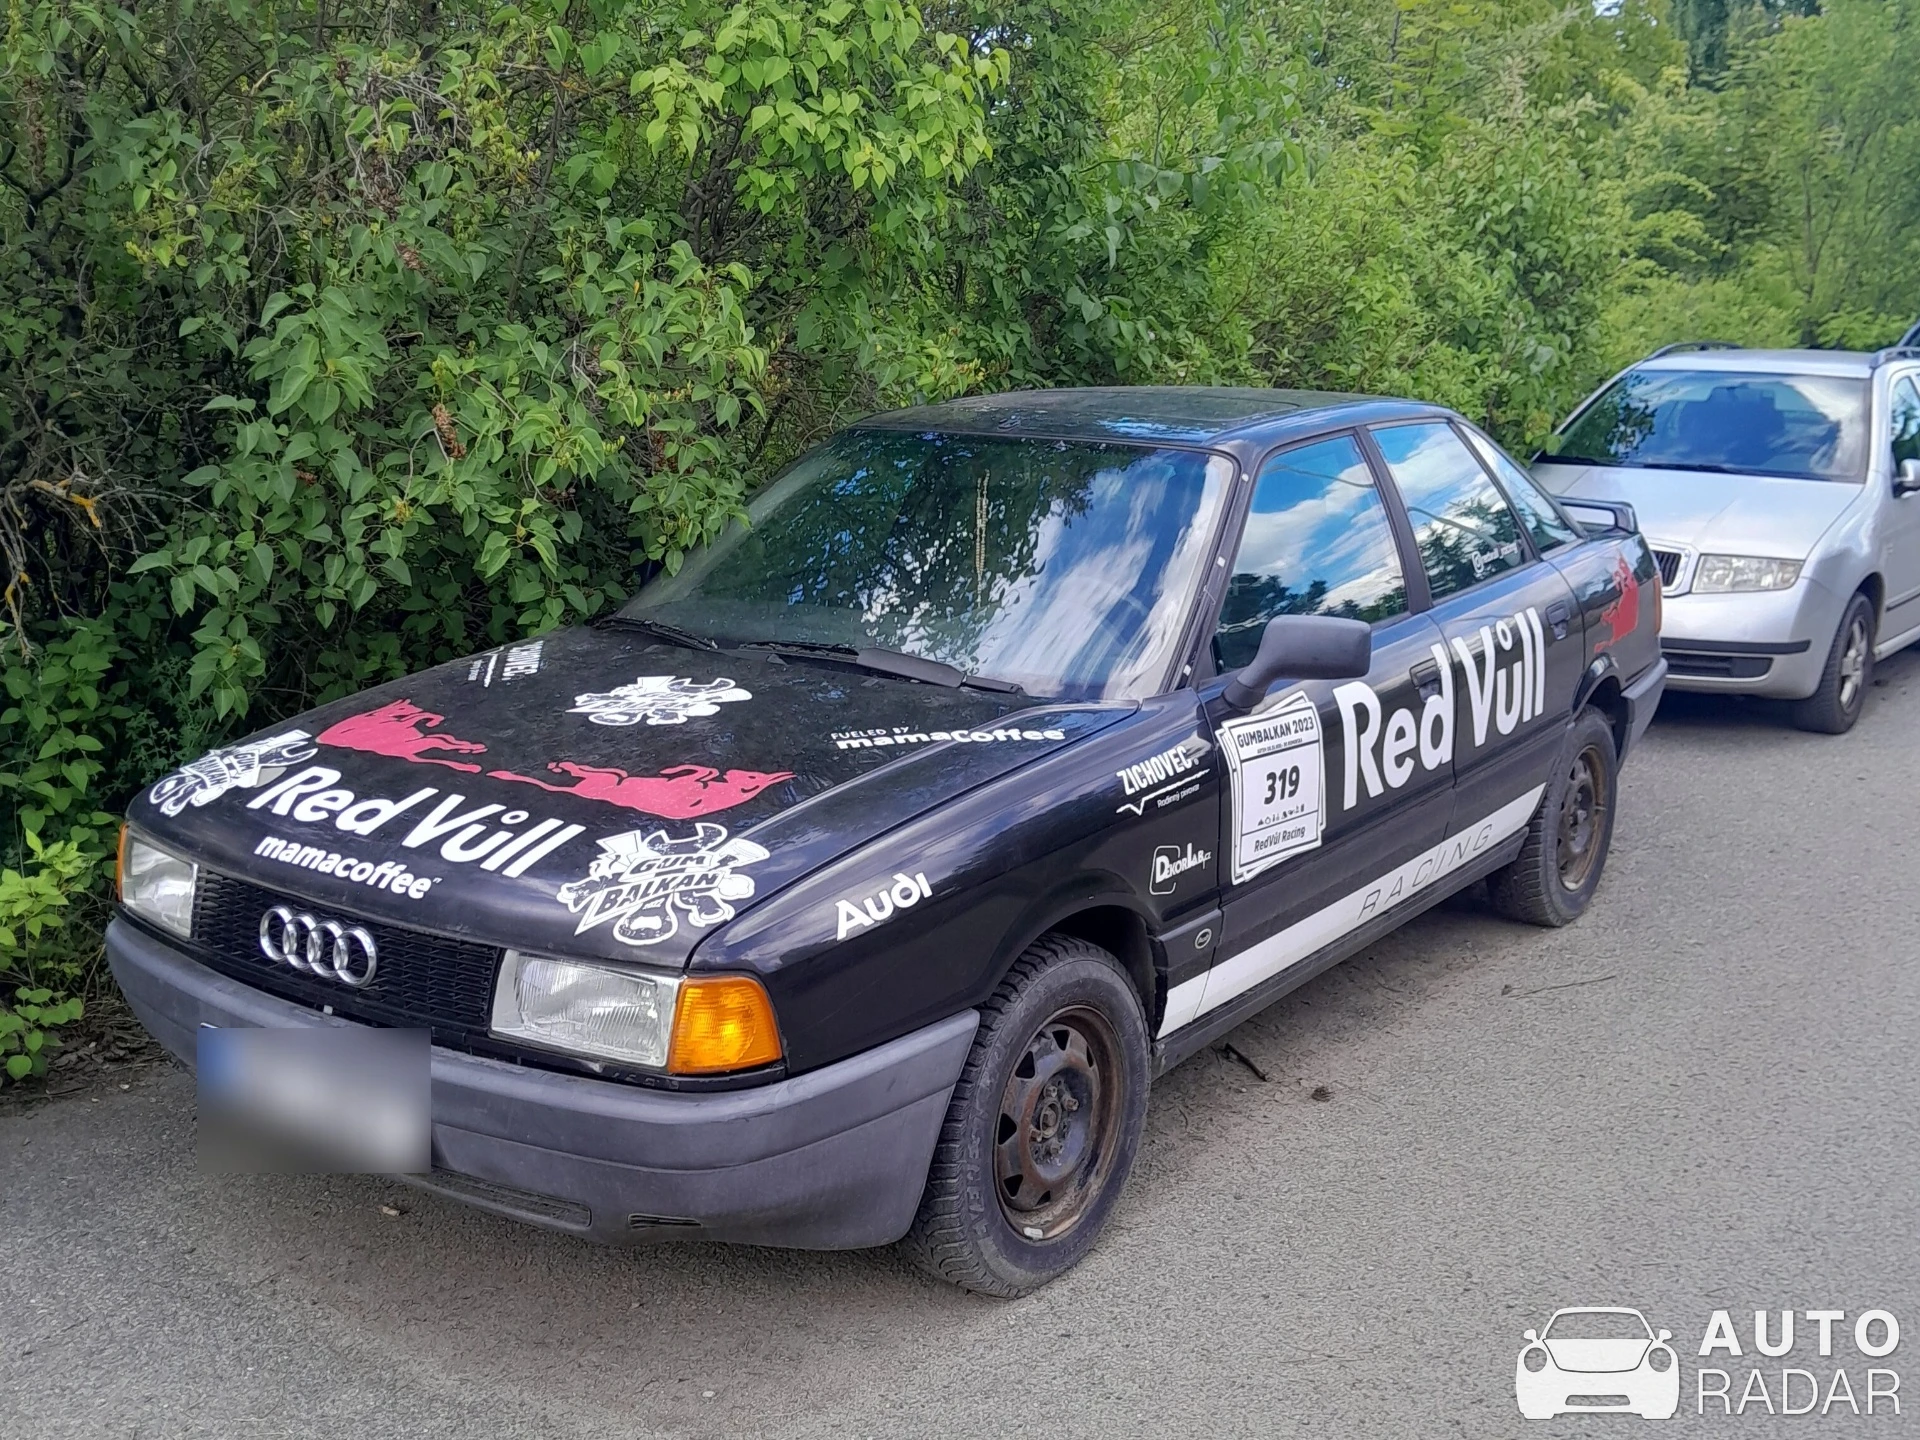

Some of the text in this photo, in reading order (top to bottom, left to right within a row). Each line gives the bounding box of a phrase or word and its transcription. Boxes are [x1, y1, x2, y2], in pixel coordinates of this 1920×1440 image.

[1332, 607, 1545, 811] Red Vůll
[831, 726, 909, 740] FUELED BY
[1237, 726, 1291, 748] GUMBALKAN
[1292, 716, 1314, 735] 2023
[246, 766, 439, 836] Red
[1264, 765, 1300, 805] 319
[1281, 826, 1306, 844] Racing
[254, 836, 434, 899] mamacoffee
[629, 855, 706, 875] GUM
[1357, 823, 1493, 920] RACING
[600, 872, 720, 911] BALKAN
[834, 872, 933, 941] Audi
